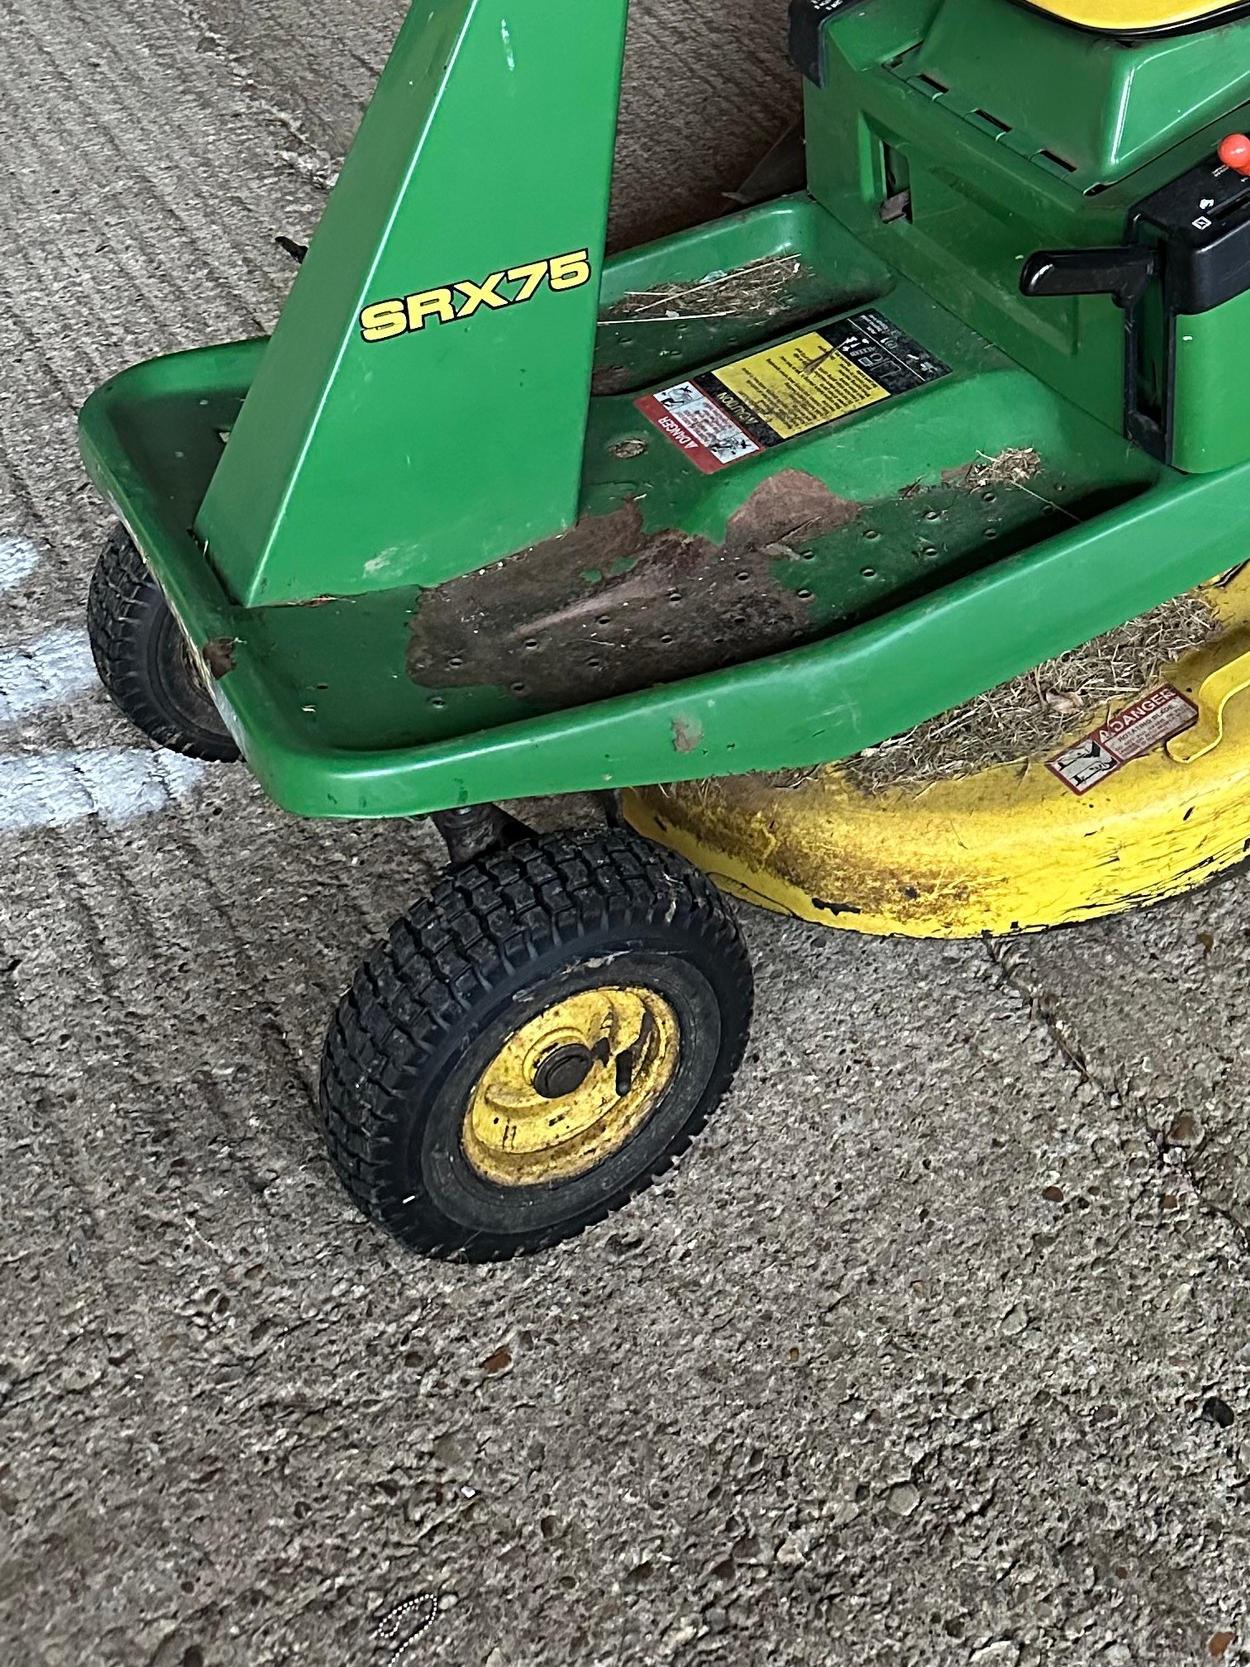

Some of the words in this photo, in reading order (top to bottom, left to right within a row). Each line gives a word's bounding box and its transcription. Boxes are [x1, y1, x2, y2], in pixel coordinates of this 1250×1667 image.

[360, 248, 591, 343] SRX75
[716, 391, 748, 421] CAUTION
[657, 416, 691, 446] DANGER
[1109, 687, 1176, 732] DANGER
